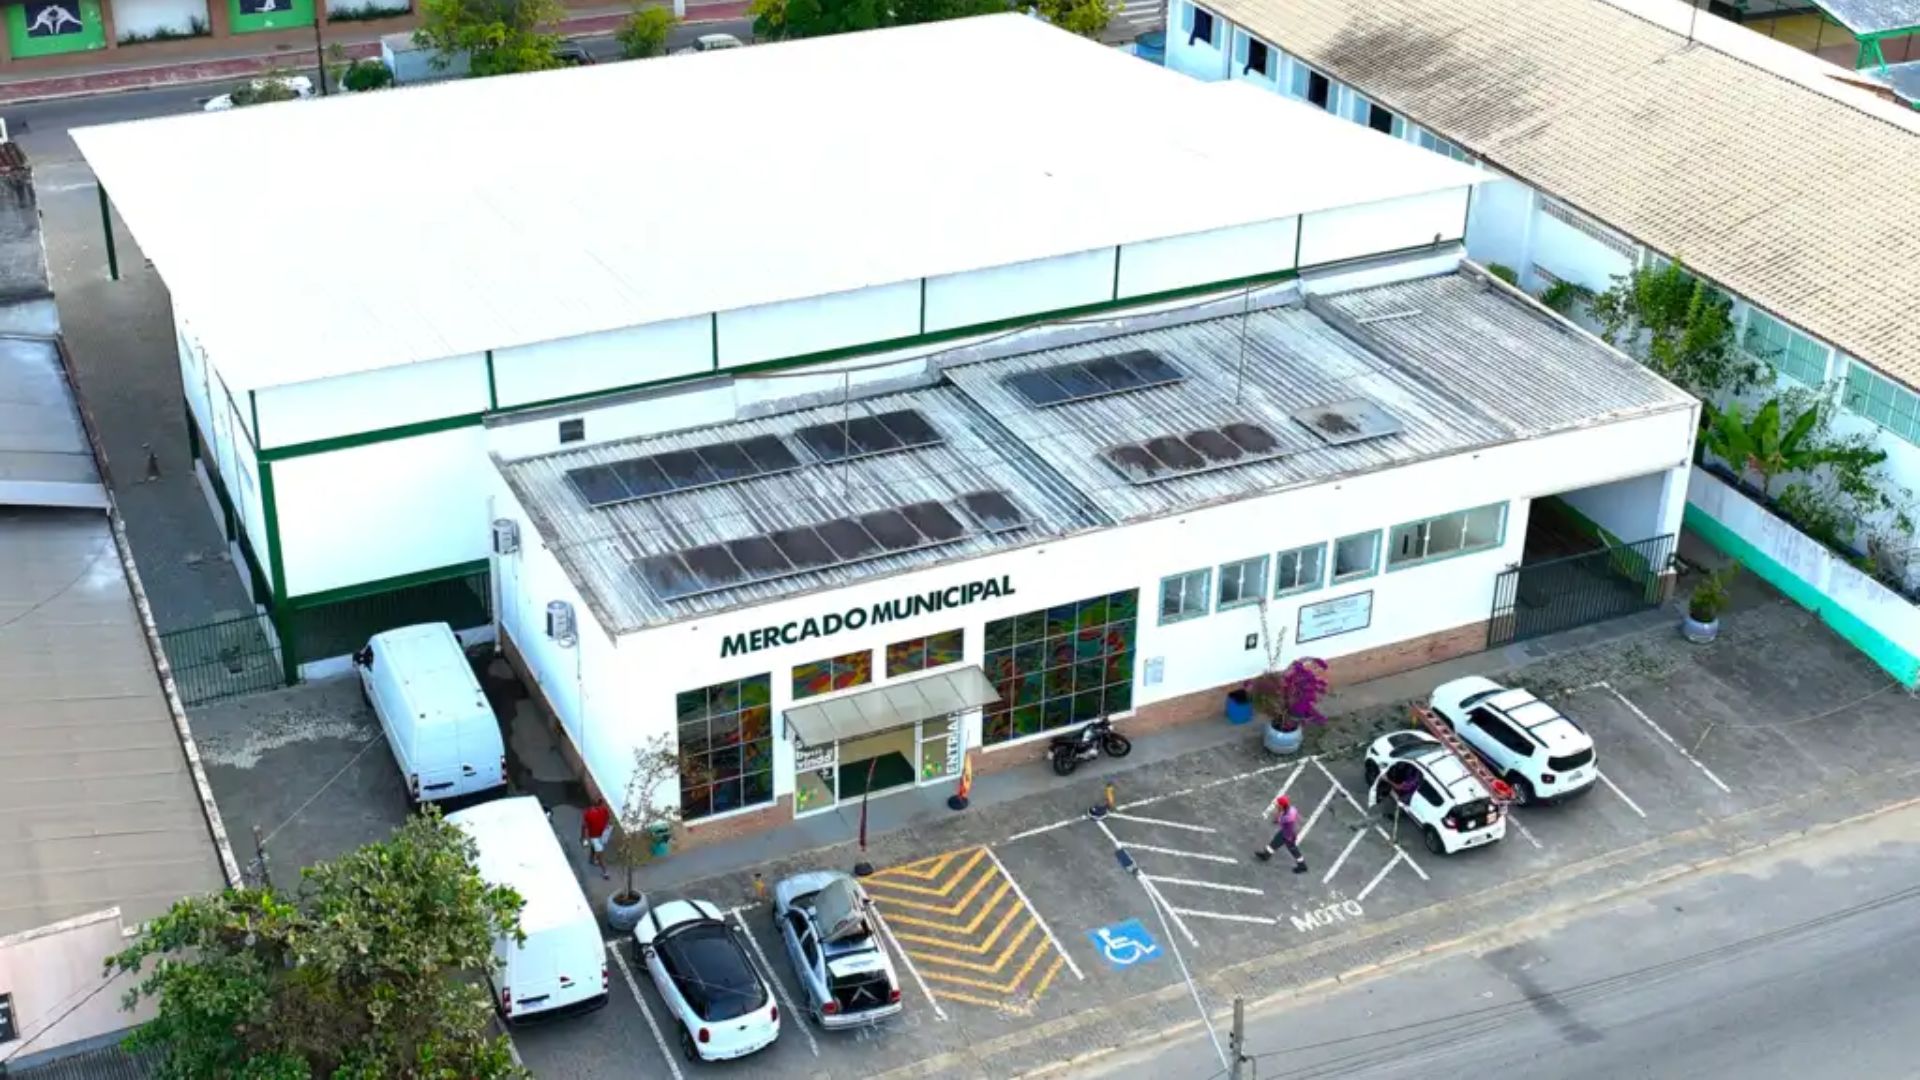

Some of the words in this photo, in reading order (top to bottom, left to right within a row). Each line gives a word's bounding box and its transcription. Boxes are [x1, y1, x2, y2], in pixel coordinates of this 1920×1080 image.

[720, 607, 867, 658] MERCADO
[871, 575, 1015, 625] MUNICIPAL
[1289, 900, 1363, 932] MOTO
